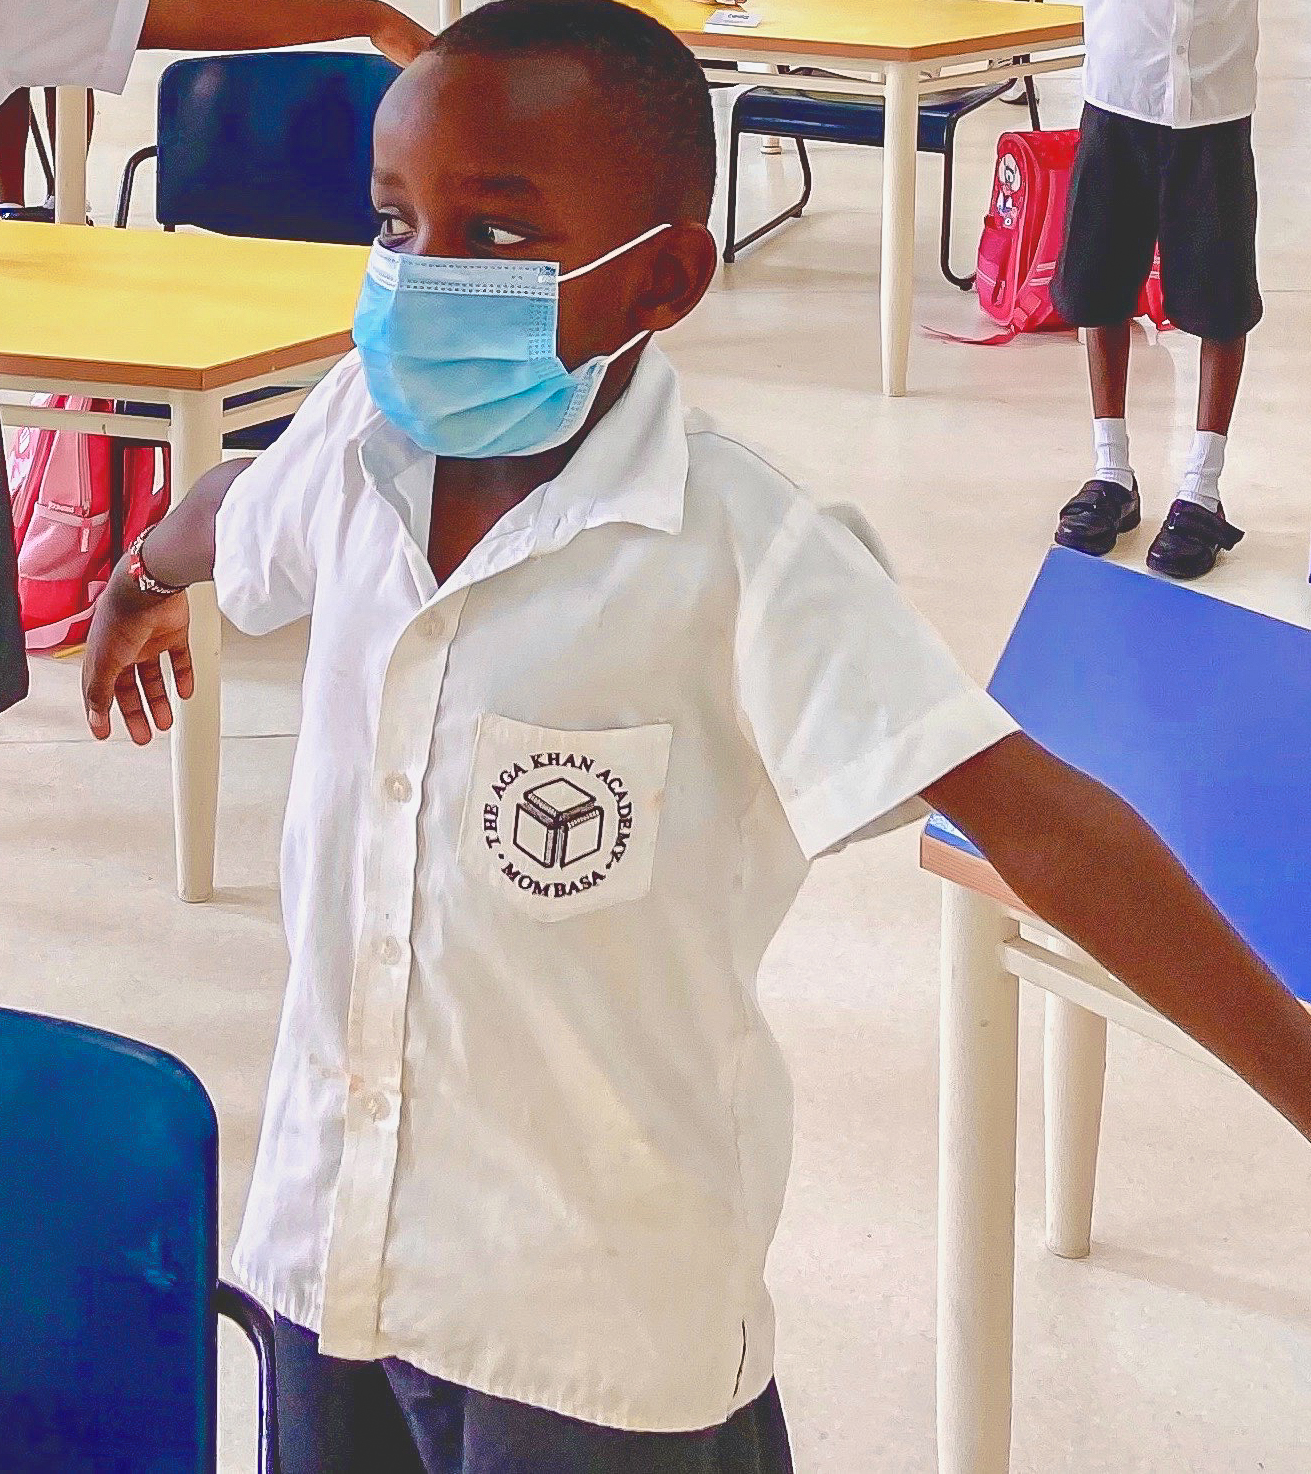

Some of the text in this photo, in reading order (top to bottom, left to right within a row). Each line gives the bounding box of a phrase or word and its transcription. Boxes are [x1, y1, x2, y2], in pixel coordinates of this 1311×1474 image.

[483, 752, 633, 863] THE AGA KHAN ACADEMY
[501, 861, 607, 899] MOMBASA
